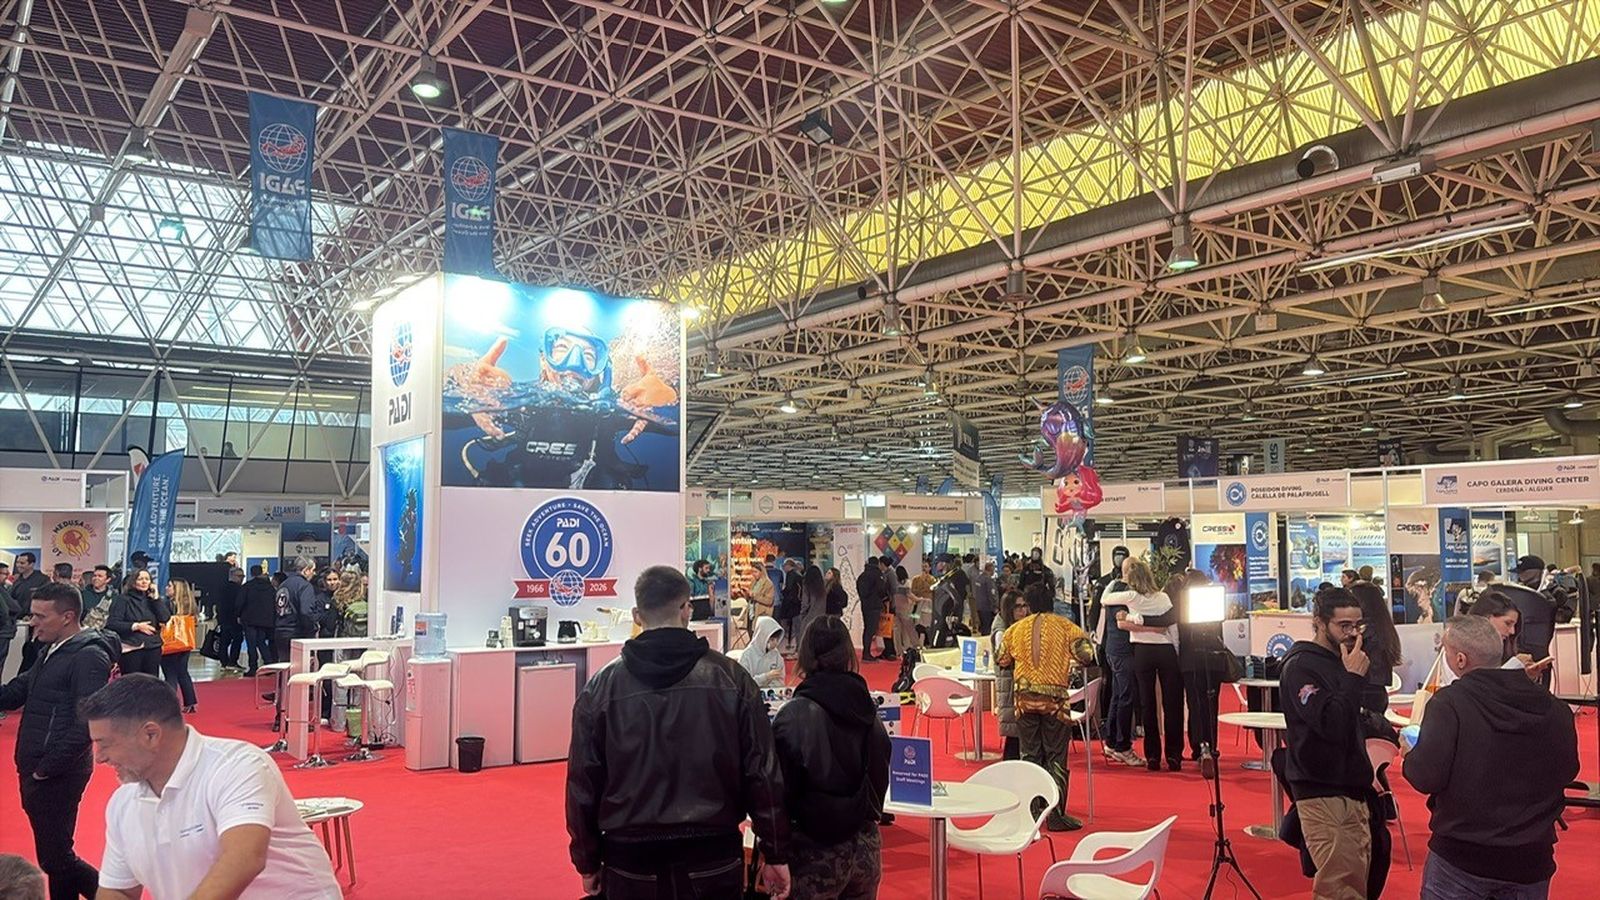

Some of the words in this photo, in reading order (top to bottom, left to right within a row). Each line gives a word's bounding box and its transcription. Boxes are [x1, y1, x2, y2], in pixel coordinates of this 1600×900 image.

[388, 392, 411, 425] PADI
[1467, 480, 1489, 488] CAPO
[1490, 479, 1523, 487] GALERA
[1525, 477, 1553, 485] DIVING
[1555, 476, 1589, 484] CENTER
[160, 508, 168, 524] THE
[273, 506, 300, 514] ATLANTIS
[52, 519, 84, 534] MEDUSA
[524, 528, 533, 547] SEEK
[531, 503, 566, 527] ADVENTURE
[556, 518, 580, 528] PADI
[573, 503, 589, 513] SAVE
[590, 511, 600, 523] THE
[599, 523, 609, 547] OCEAN
[148, 526, 157, 548] SEEK
[545, 532, 590, 568] 60
[526, 585, 544, 593] 1966
[589, 583, 607, 592] 2026
